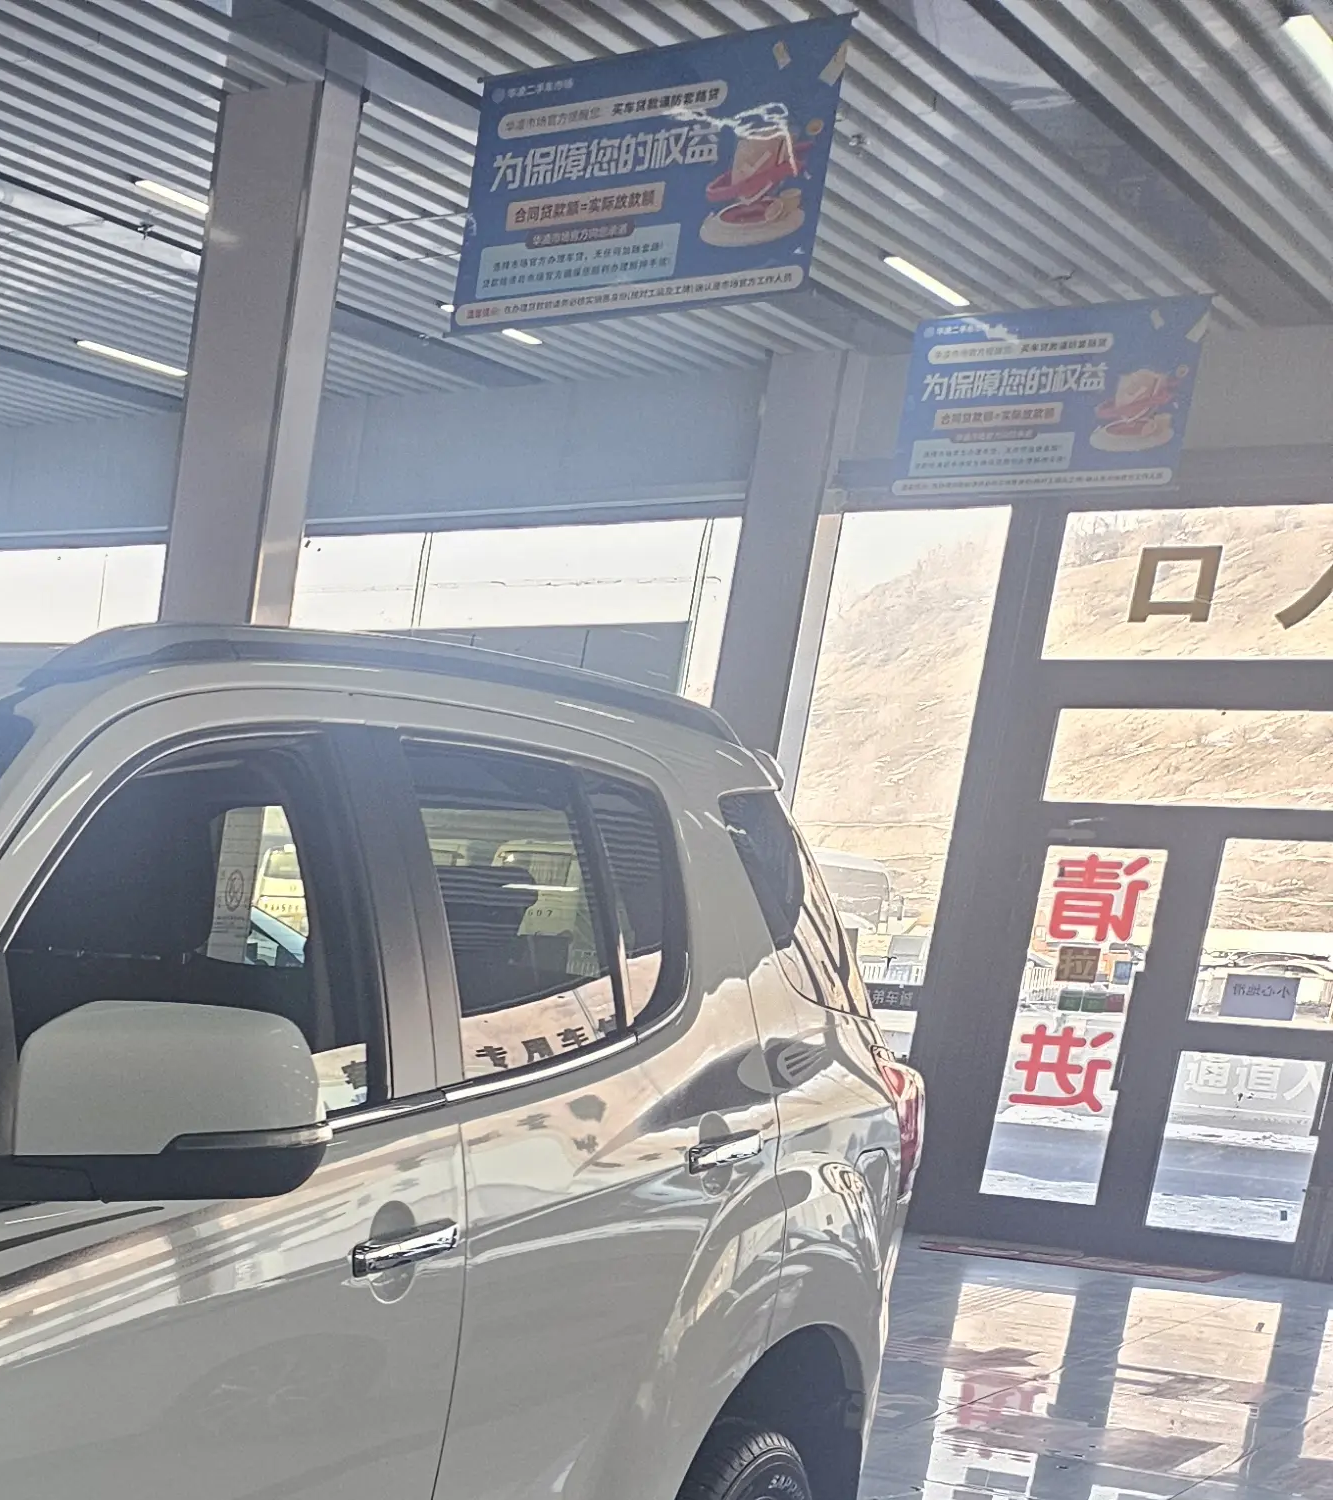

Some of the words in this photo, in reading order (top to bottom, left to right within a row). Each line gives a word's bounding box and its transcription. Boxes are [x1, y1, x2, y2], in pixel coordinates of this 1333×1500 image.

[490, 124, 722, 192] 为保障您的权益
[921, 362, 1109, 402] 为保障您的权益
[1060, 949, 1097, 980] 拉
